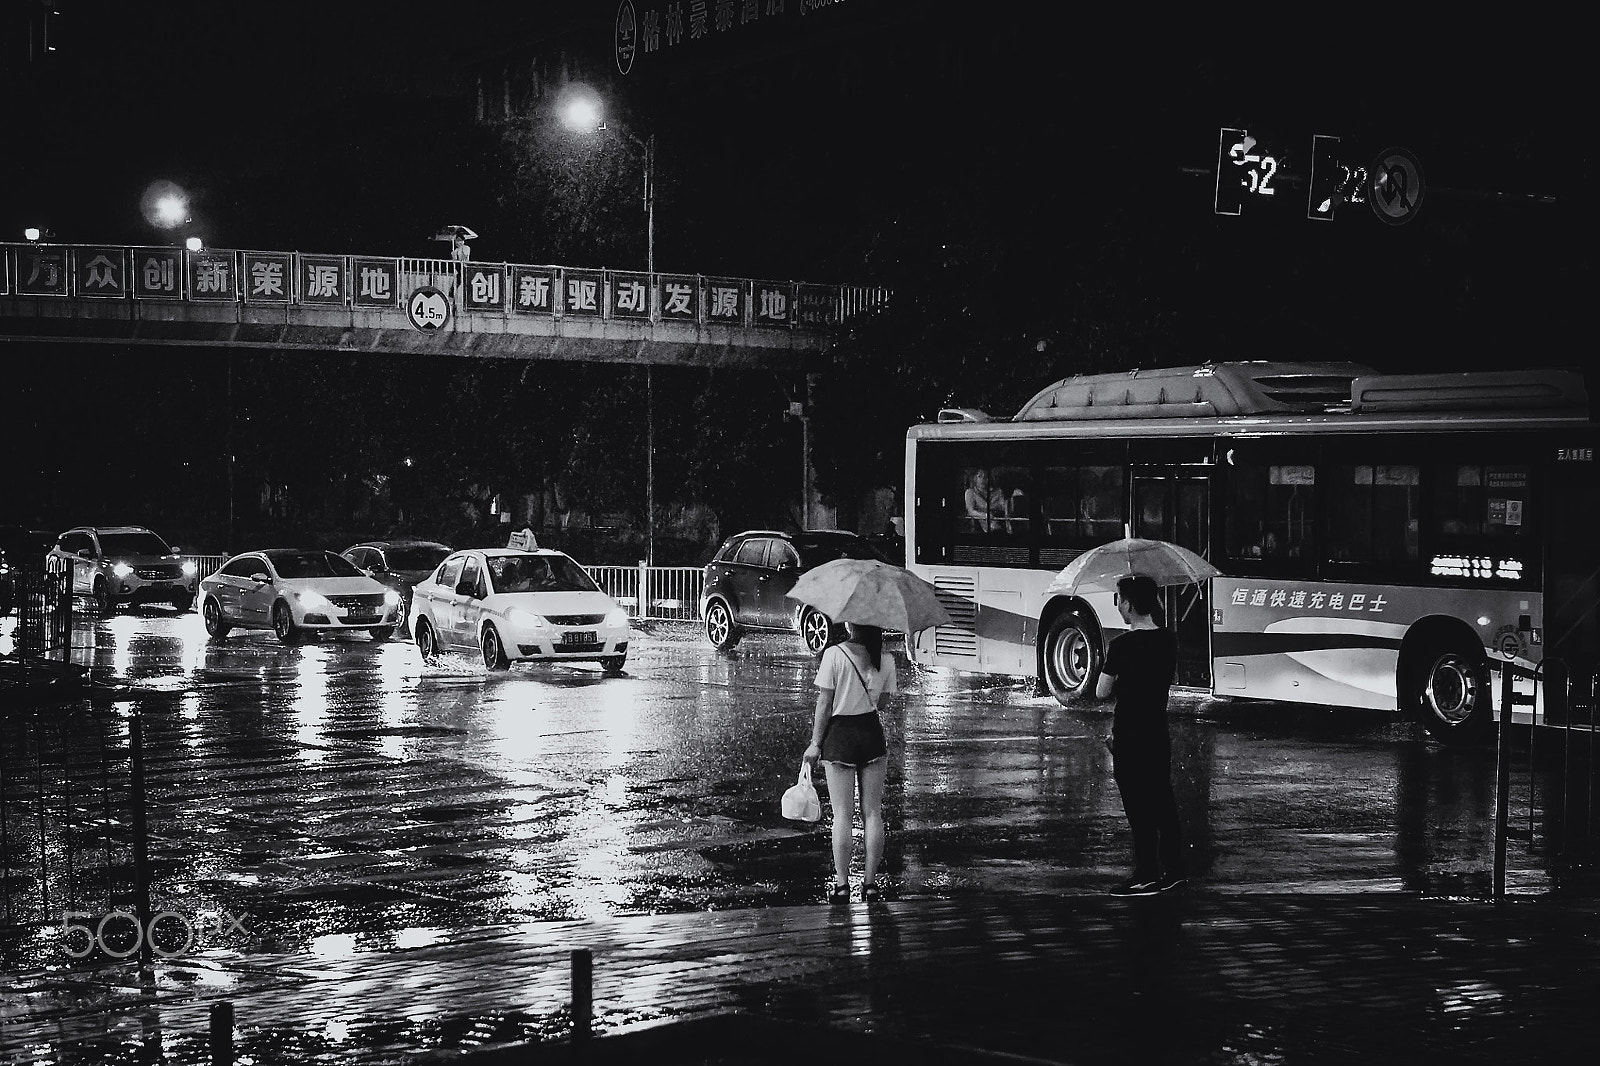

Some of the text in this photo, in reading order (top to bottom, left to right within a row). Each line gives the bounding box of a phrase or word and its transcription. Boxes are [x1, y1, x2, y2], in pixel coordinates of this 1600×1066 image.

[470, 271, 786, 320] 创新驱动发源地
[415, 301, 443, 319] 4.5m
[1231, 588, 1387, 612] 恒通快速充电巴士
